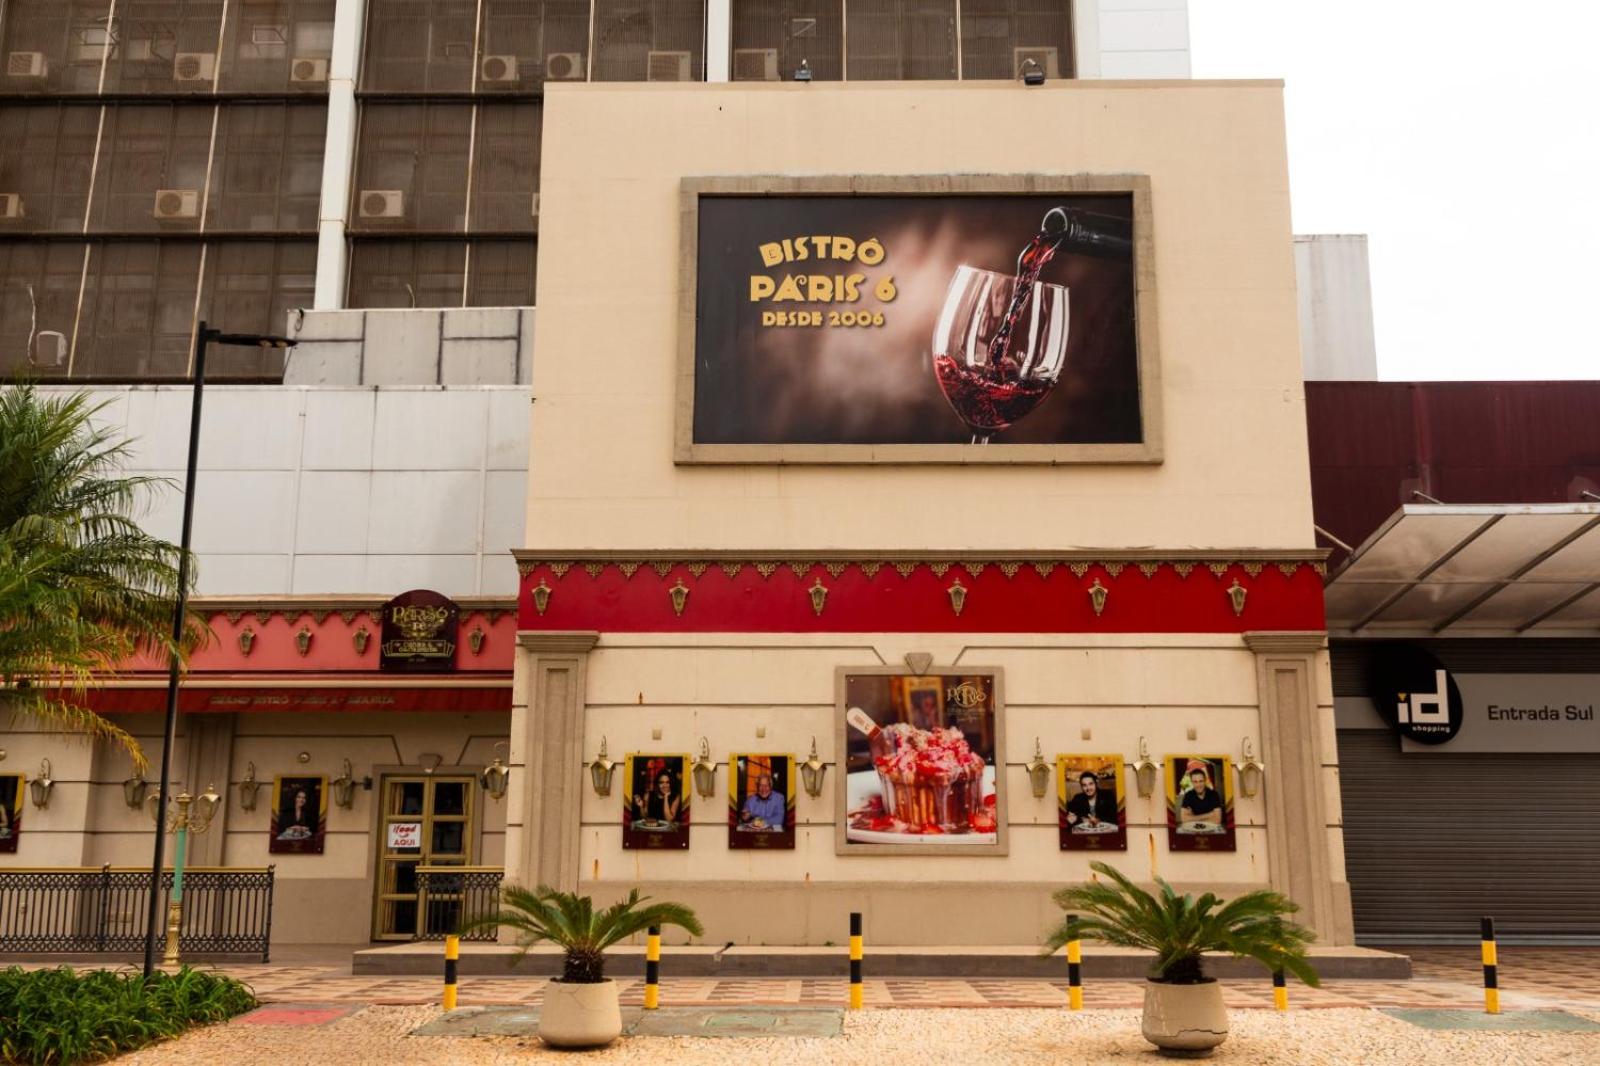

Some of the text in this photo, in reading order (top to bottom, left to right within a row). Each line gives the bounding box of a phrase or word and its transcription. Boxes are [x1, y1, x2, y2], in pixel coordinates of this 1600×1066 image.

[759, 236, 885, 267] BISTRÔ
[750, 273, 897, 302] PARIS 6
[762, 310, 885, 327] DESDE 2006
[1397, 669, 1450, 723] id
[1487, 704, 1594, 721] Entrada Sul
[1412, 725, 1451, 734] shopping
[394, 838, 416, 847] AQUI
